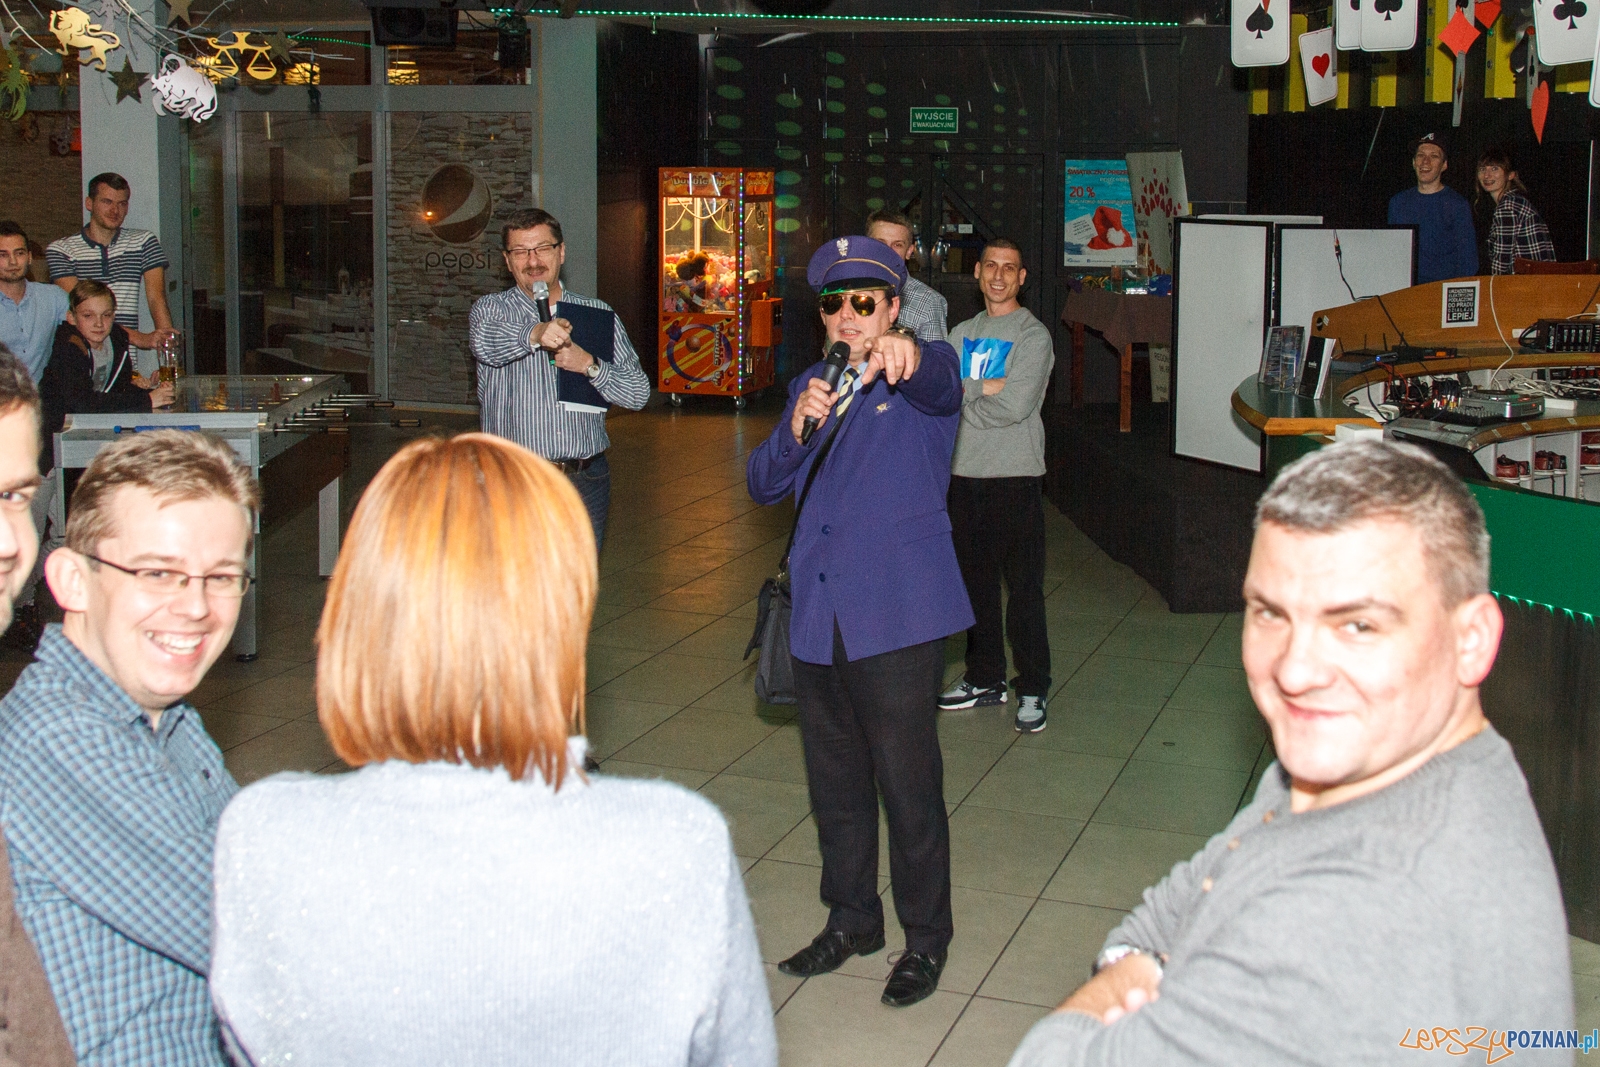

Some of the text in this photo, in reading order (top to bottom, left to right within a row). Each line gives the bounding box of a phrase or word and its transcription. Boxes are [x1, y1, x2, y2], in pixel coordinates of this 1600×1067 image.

[915, 111, 954, 120] WYJŚCIE
[672, 175, 709, 186] Doble
[1070, 186, 1096, 198] 20 %
[426, 249, 490, 273] pepsi
[1448, 312, 1473, 320] LEPIEJ
[712, 322, 724, 386] Double Up
